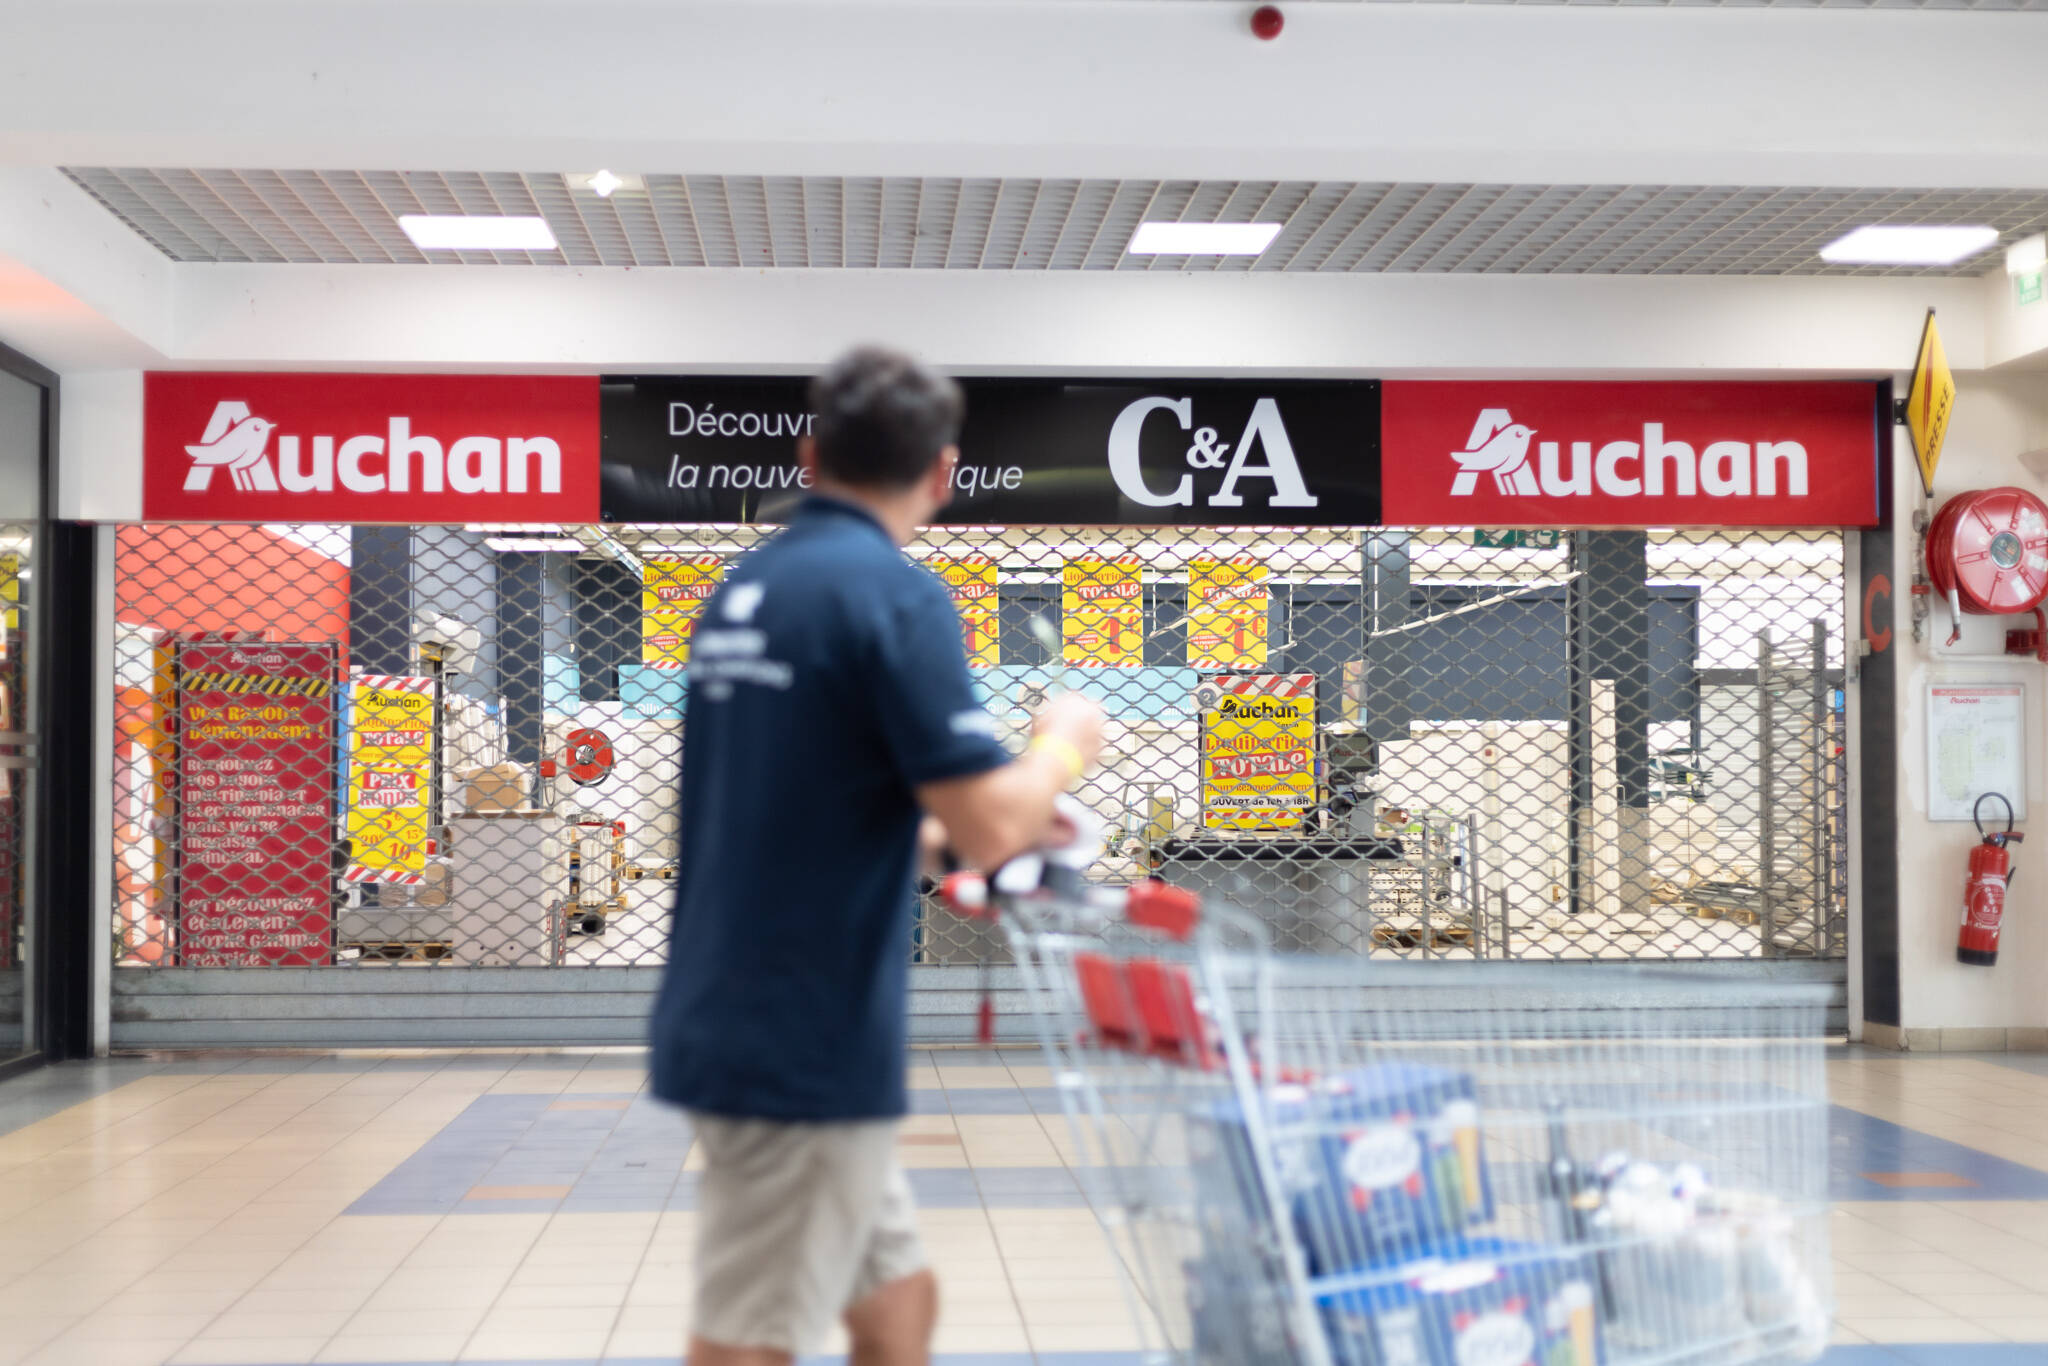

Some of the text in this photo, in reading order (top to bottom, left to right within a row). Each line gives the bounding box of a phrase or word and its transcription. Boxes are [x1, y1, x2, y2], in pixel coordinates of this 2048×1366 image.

[183, 401, 561, 493] Auchan
[668, 403, 818, 437] Découvr
[1108, 397, 1317, 507] C&A
[1450, 409, 1808, 497] Auchan
[1926, 381, 1951, 467] PRESSE
[668, 455, 1023, 497] la nouve ique
[1219, 699, 1299, 718] Auchan
